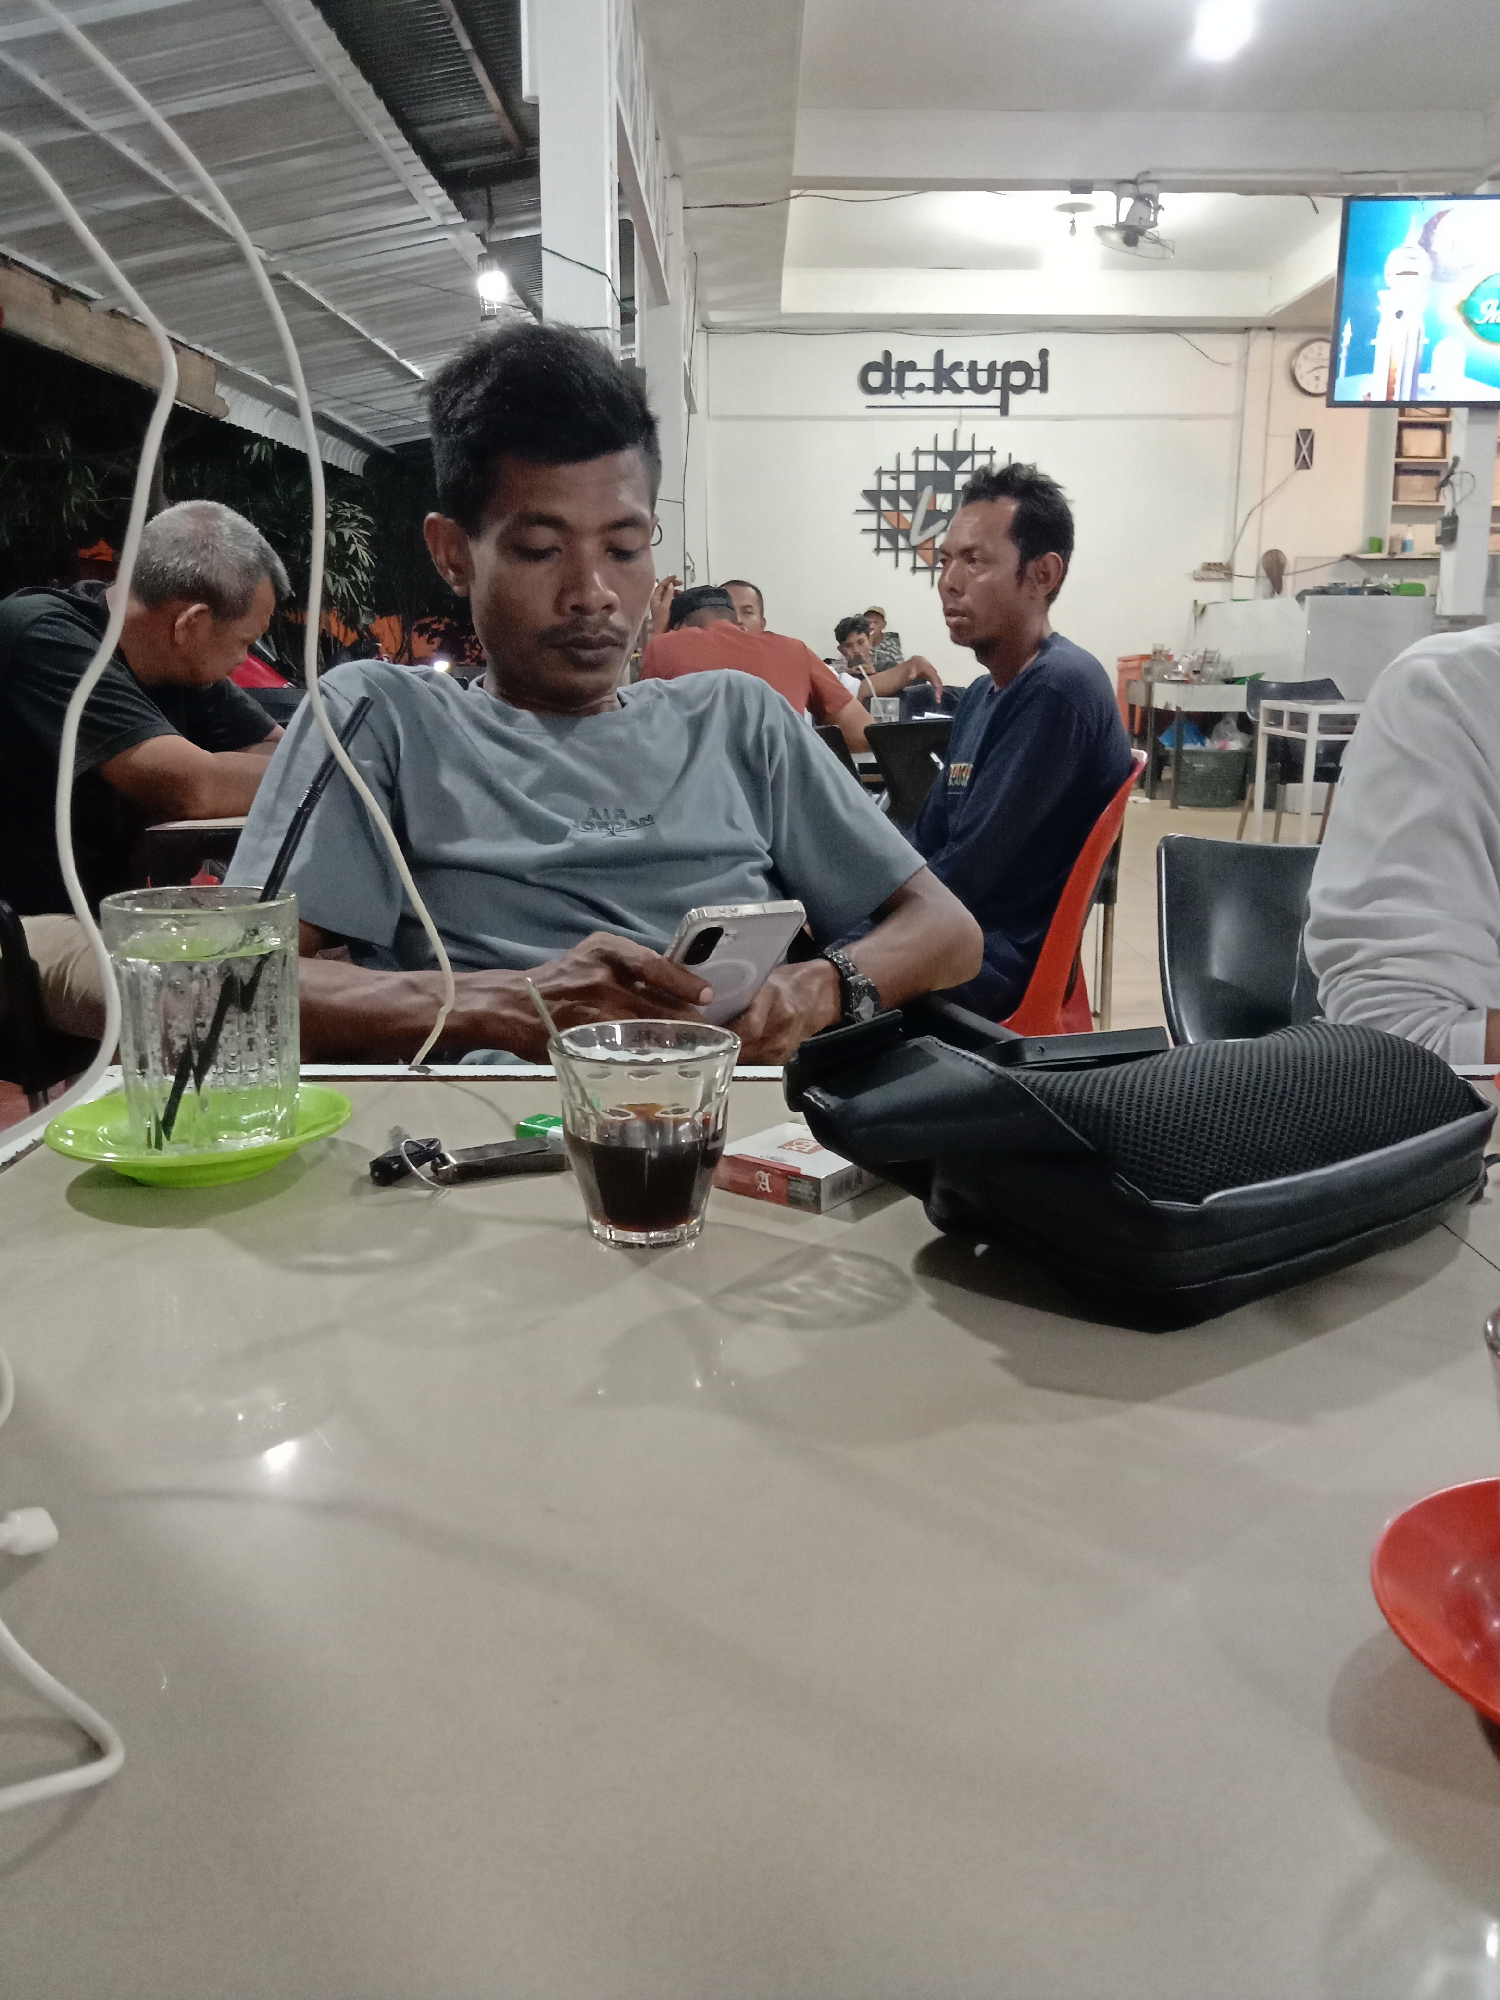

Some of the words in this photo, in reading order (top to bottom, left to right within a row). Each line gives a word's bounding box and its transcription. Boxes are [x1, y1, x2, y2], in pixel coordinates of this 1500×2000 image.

[859, 348, 1049, 417] dr.kupi
[586, 807, 627, 820] AIR
[755, 1170, 772, 1193] A
